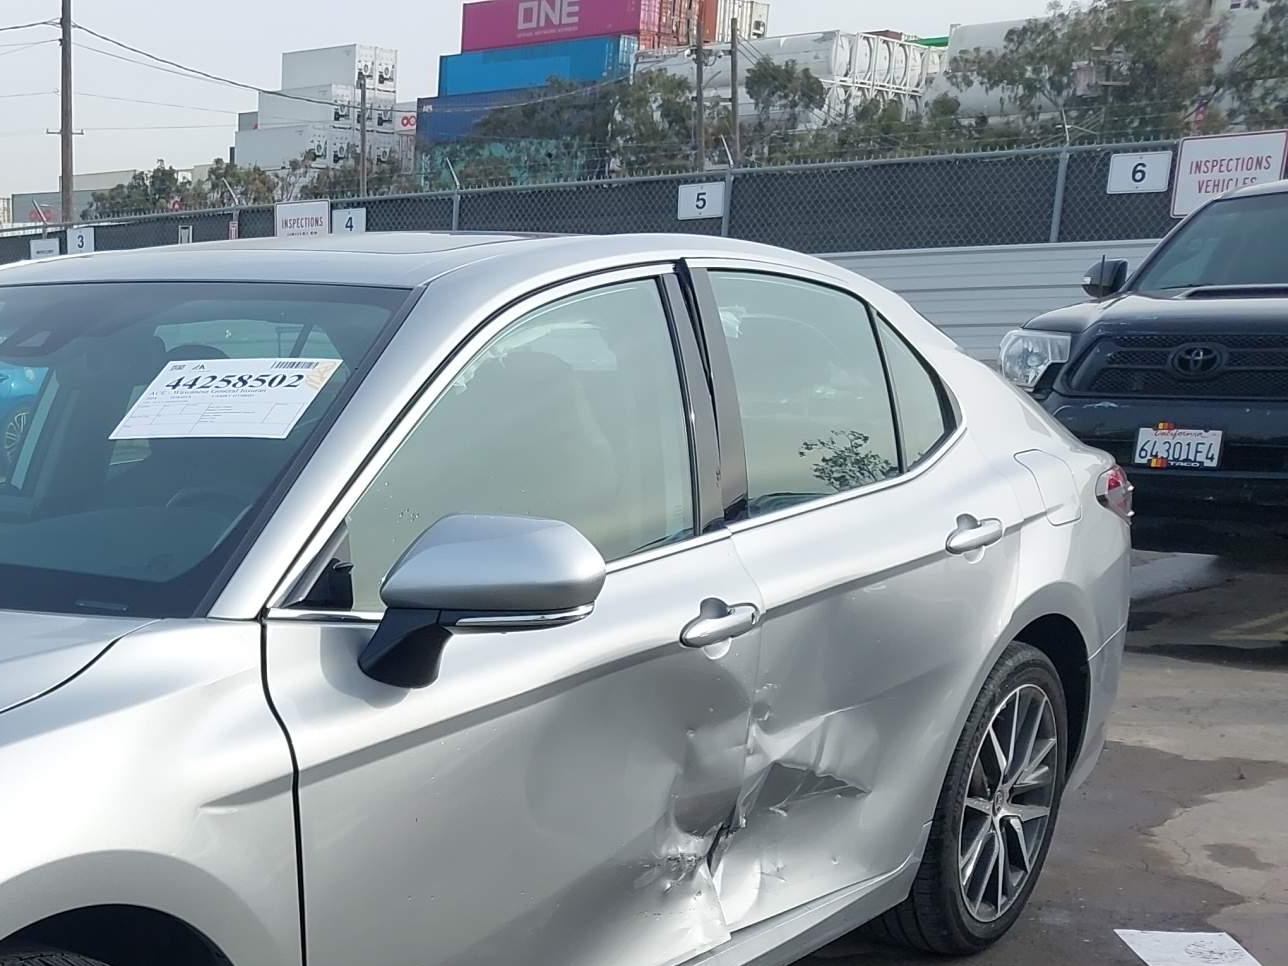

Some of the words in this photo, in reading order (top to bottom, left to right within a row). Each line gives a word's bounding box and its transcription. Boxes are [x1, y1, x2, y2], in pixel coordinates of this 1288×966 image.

[518, 0, 579, 29] ONE
[1131, 163, 1146, 182] 6
[1189, 155, 1272, 175] INSPECTIONS
[696, 192, 706, 209] 5
[281, 216, 324, 229] INSPECTIONS
[345, 217, 353, 231] 4
[77, 235, 84, 248] 3
[165, 374, 305, 389] 44258502
